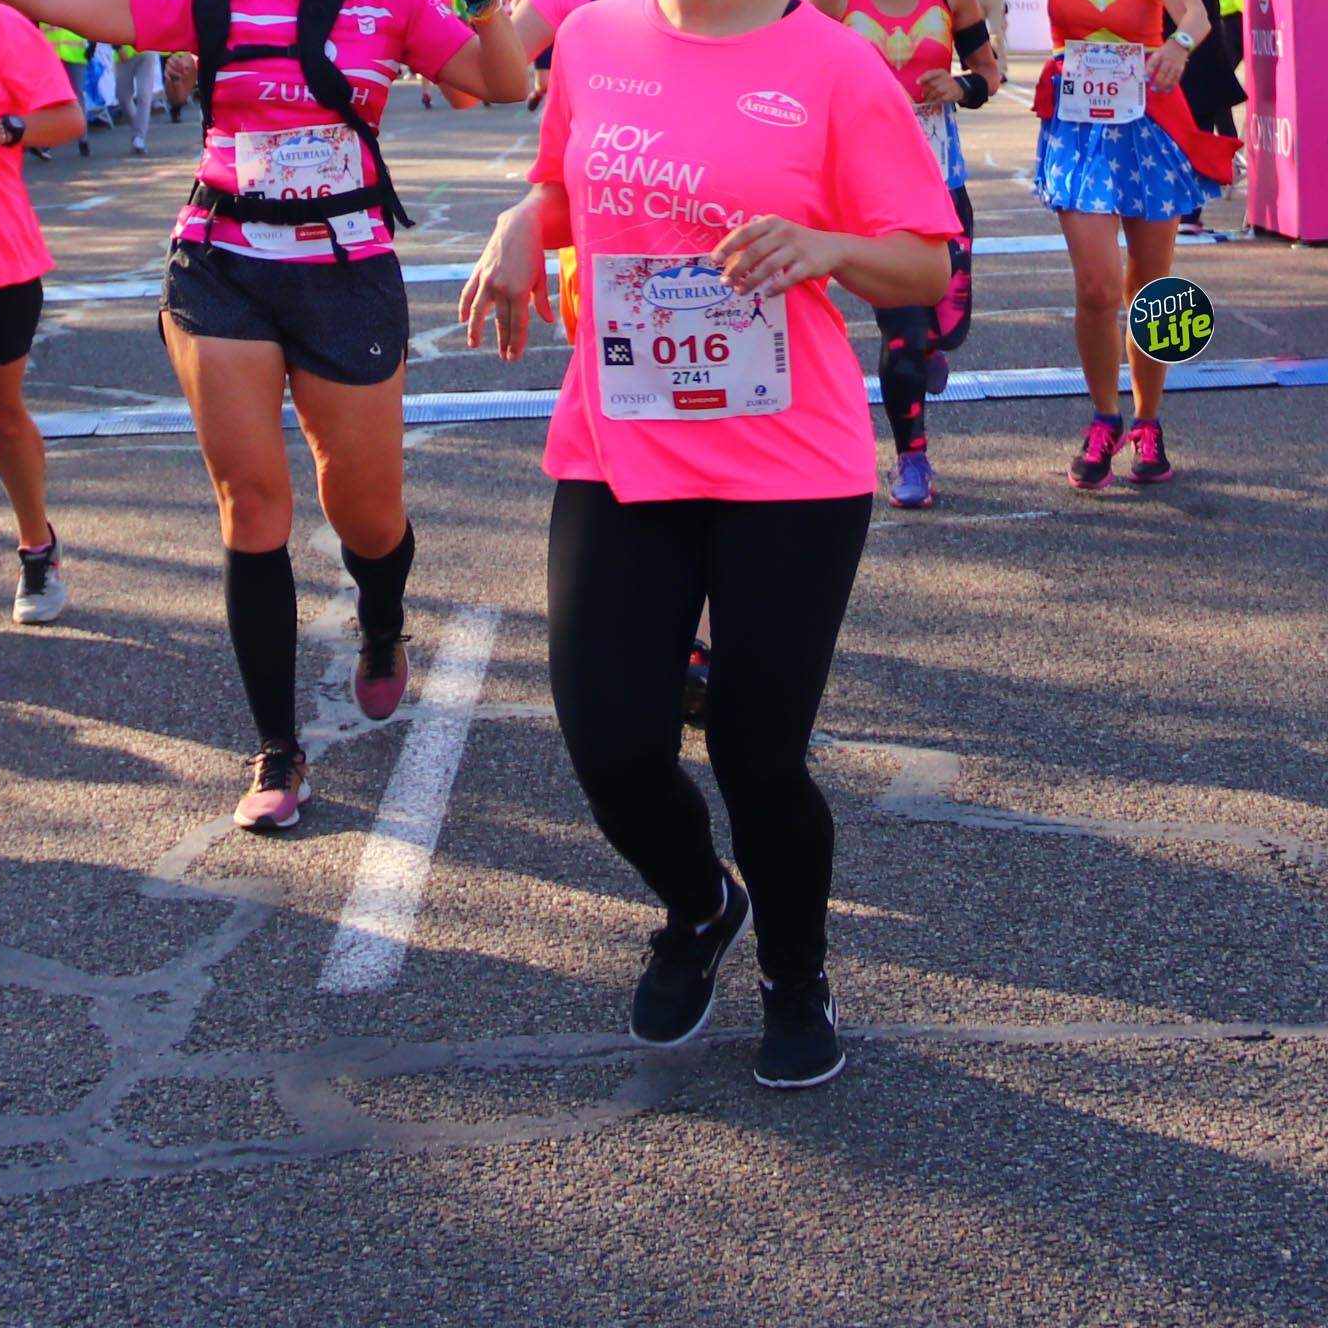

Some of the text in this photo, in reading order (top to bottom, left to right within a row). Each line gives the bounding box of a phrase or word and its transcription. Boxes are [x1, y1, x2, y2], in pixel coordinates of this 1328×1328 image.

[1251, 27, 1283, 59] ZURICH
[258, 81, 370, 107] ZURH
[588, 74, 662, 97] OYSHO
[1083, 81, 1119, 96] 016
[742, 98, 801, 123] ASTURIANA
[591, 123, 664, 154] HOY
[1250, 113, 1292, 158] OYSHO
[585, 151, 705, 195] GANAN
[587, 185, 635, 216] LAS
[649, 283, 728, 301] ASTURIANA
[652, 333, 731, 365] 016
[672, 371, 711, 385] 2741
[610, 393, 658, 405] OYSHO
[746, 398, 779, 408] ZURICH
